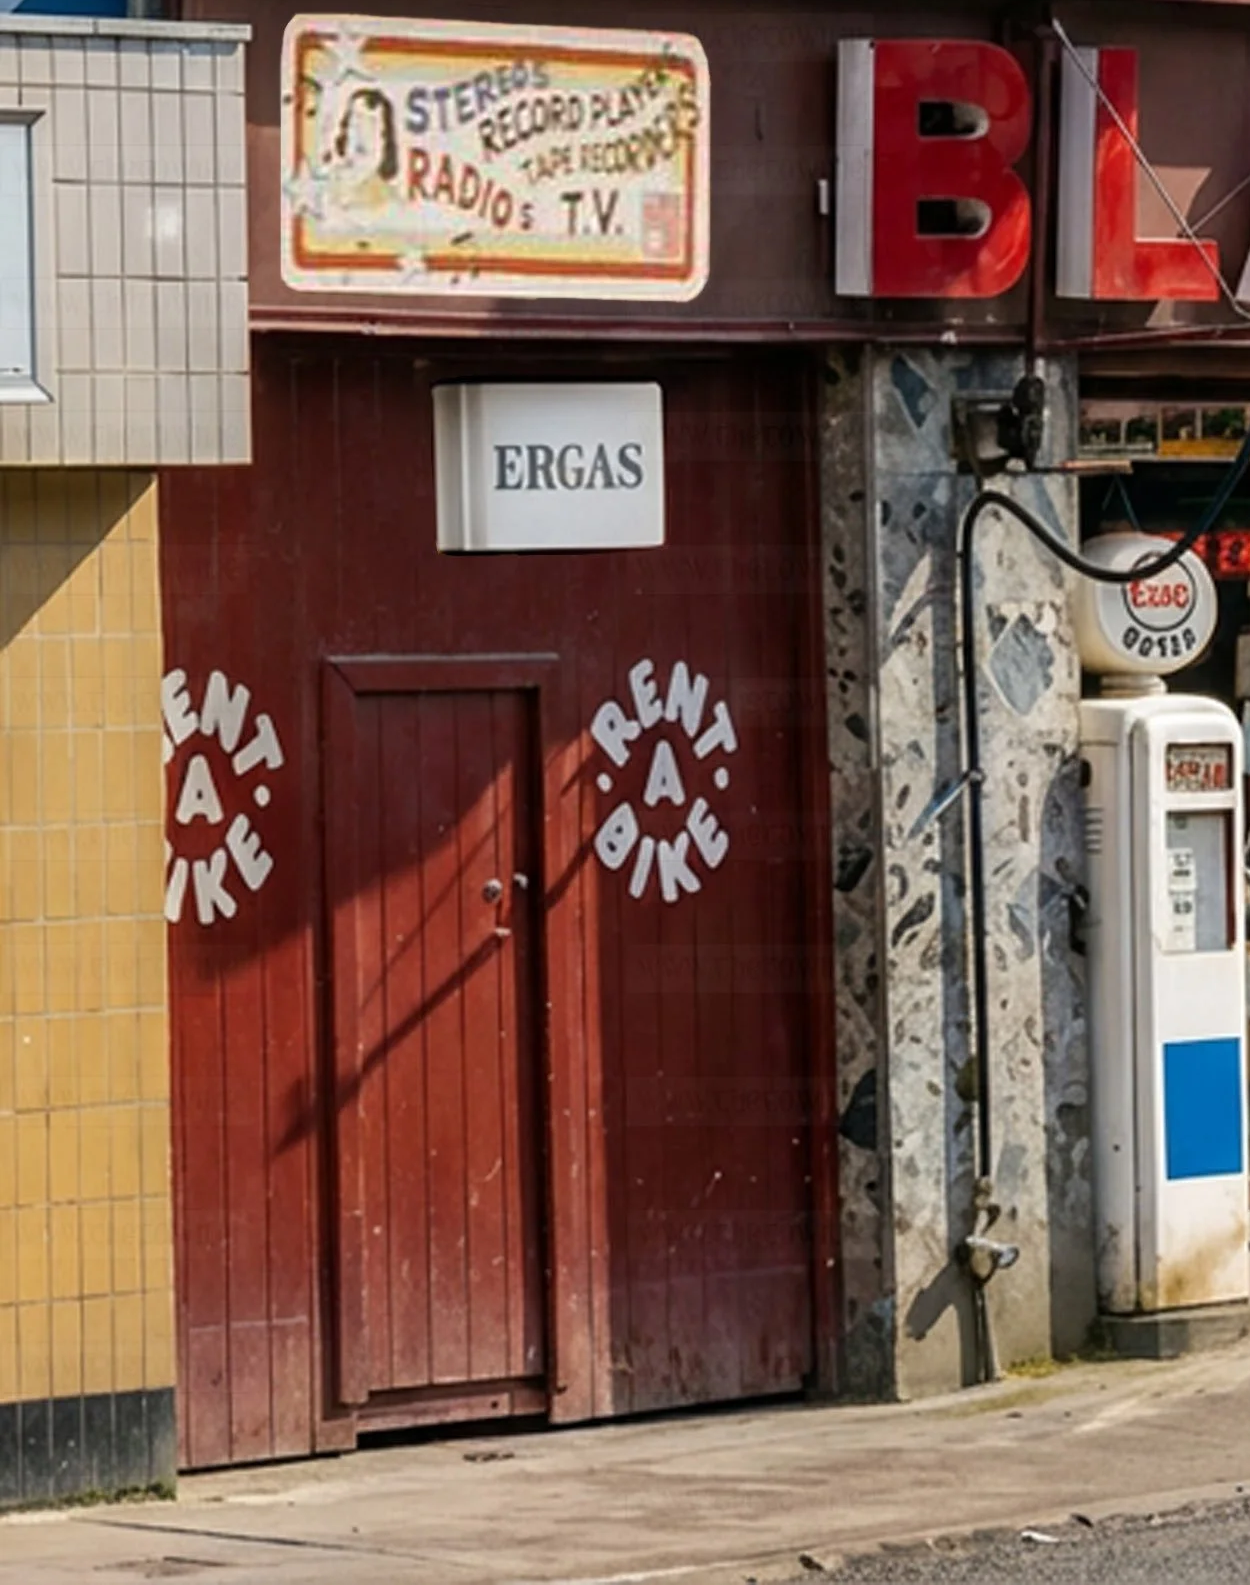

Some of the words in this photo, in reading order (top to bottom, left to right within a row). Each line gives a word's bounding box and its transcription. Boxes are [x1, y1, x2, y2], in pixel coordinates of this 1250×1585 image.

[405, 59, 550, 135] STEREOS
[478, 93, 584, 154] RECORD
[493, 442, 644, 491] ERGAS
[162, 668, 285, 777] ENT
[590, 658, 738, 767] RENT
[175, 754, 225, 826] A
[643, 740, 687, 808] A
[164, 813, 274, 926] IKE
[594, 797, 730, 904] BIKE
